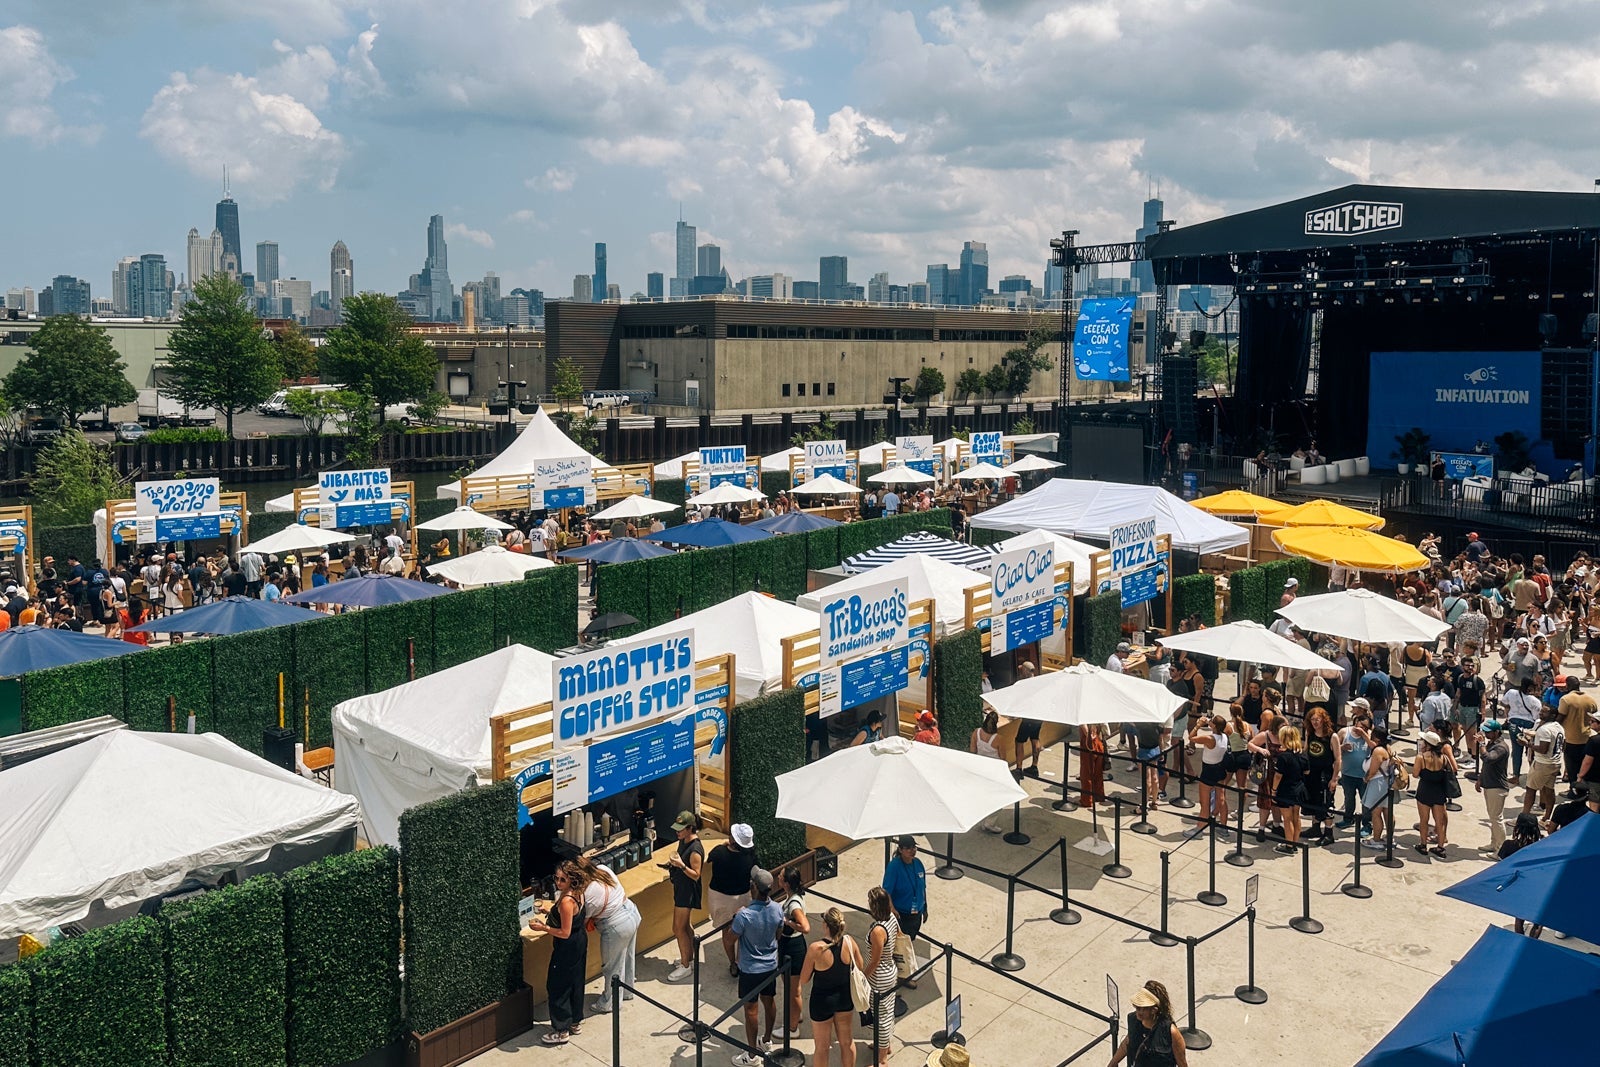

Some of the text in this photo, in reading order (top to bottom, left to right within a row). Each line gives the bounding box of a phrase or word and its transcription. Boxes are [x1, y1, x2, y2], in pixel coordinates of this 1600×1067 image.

[1091, 335, 1108, 344] CON
[1436, 389, 1530, 404] INFATUATION
[807, 444, 844, 457] TOMA
[537, 465, 556, 476] Shake
[321, 471, 388, 488] JIBARITOS
[141, 486, 164, 499] The
[152, 495, 210, 513] World
[1112, 520, 1156, 548] PROFESSOR
[1112, 540, 1156, 572] PIZZA
[994, 549, 1052, 598] Ciao Ciao
[1002, 595, 1023, 607] GELATO
[824, 588, 907, 642] TriBecca's
[828, 627, 896, 658] sandwich shop
[804, 675, 816, 684] HERE
[639, 674, 691, 717] STOP
[702, 708, 721, 719] ORDER
[524, 764, 544, 778] HERE
